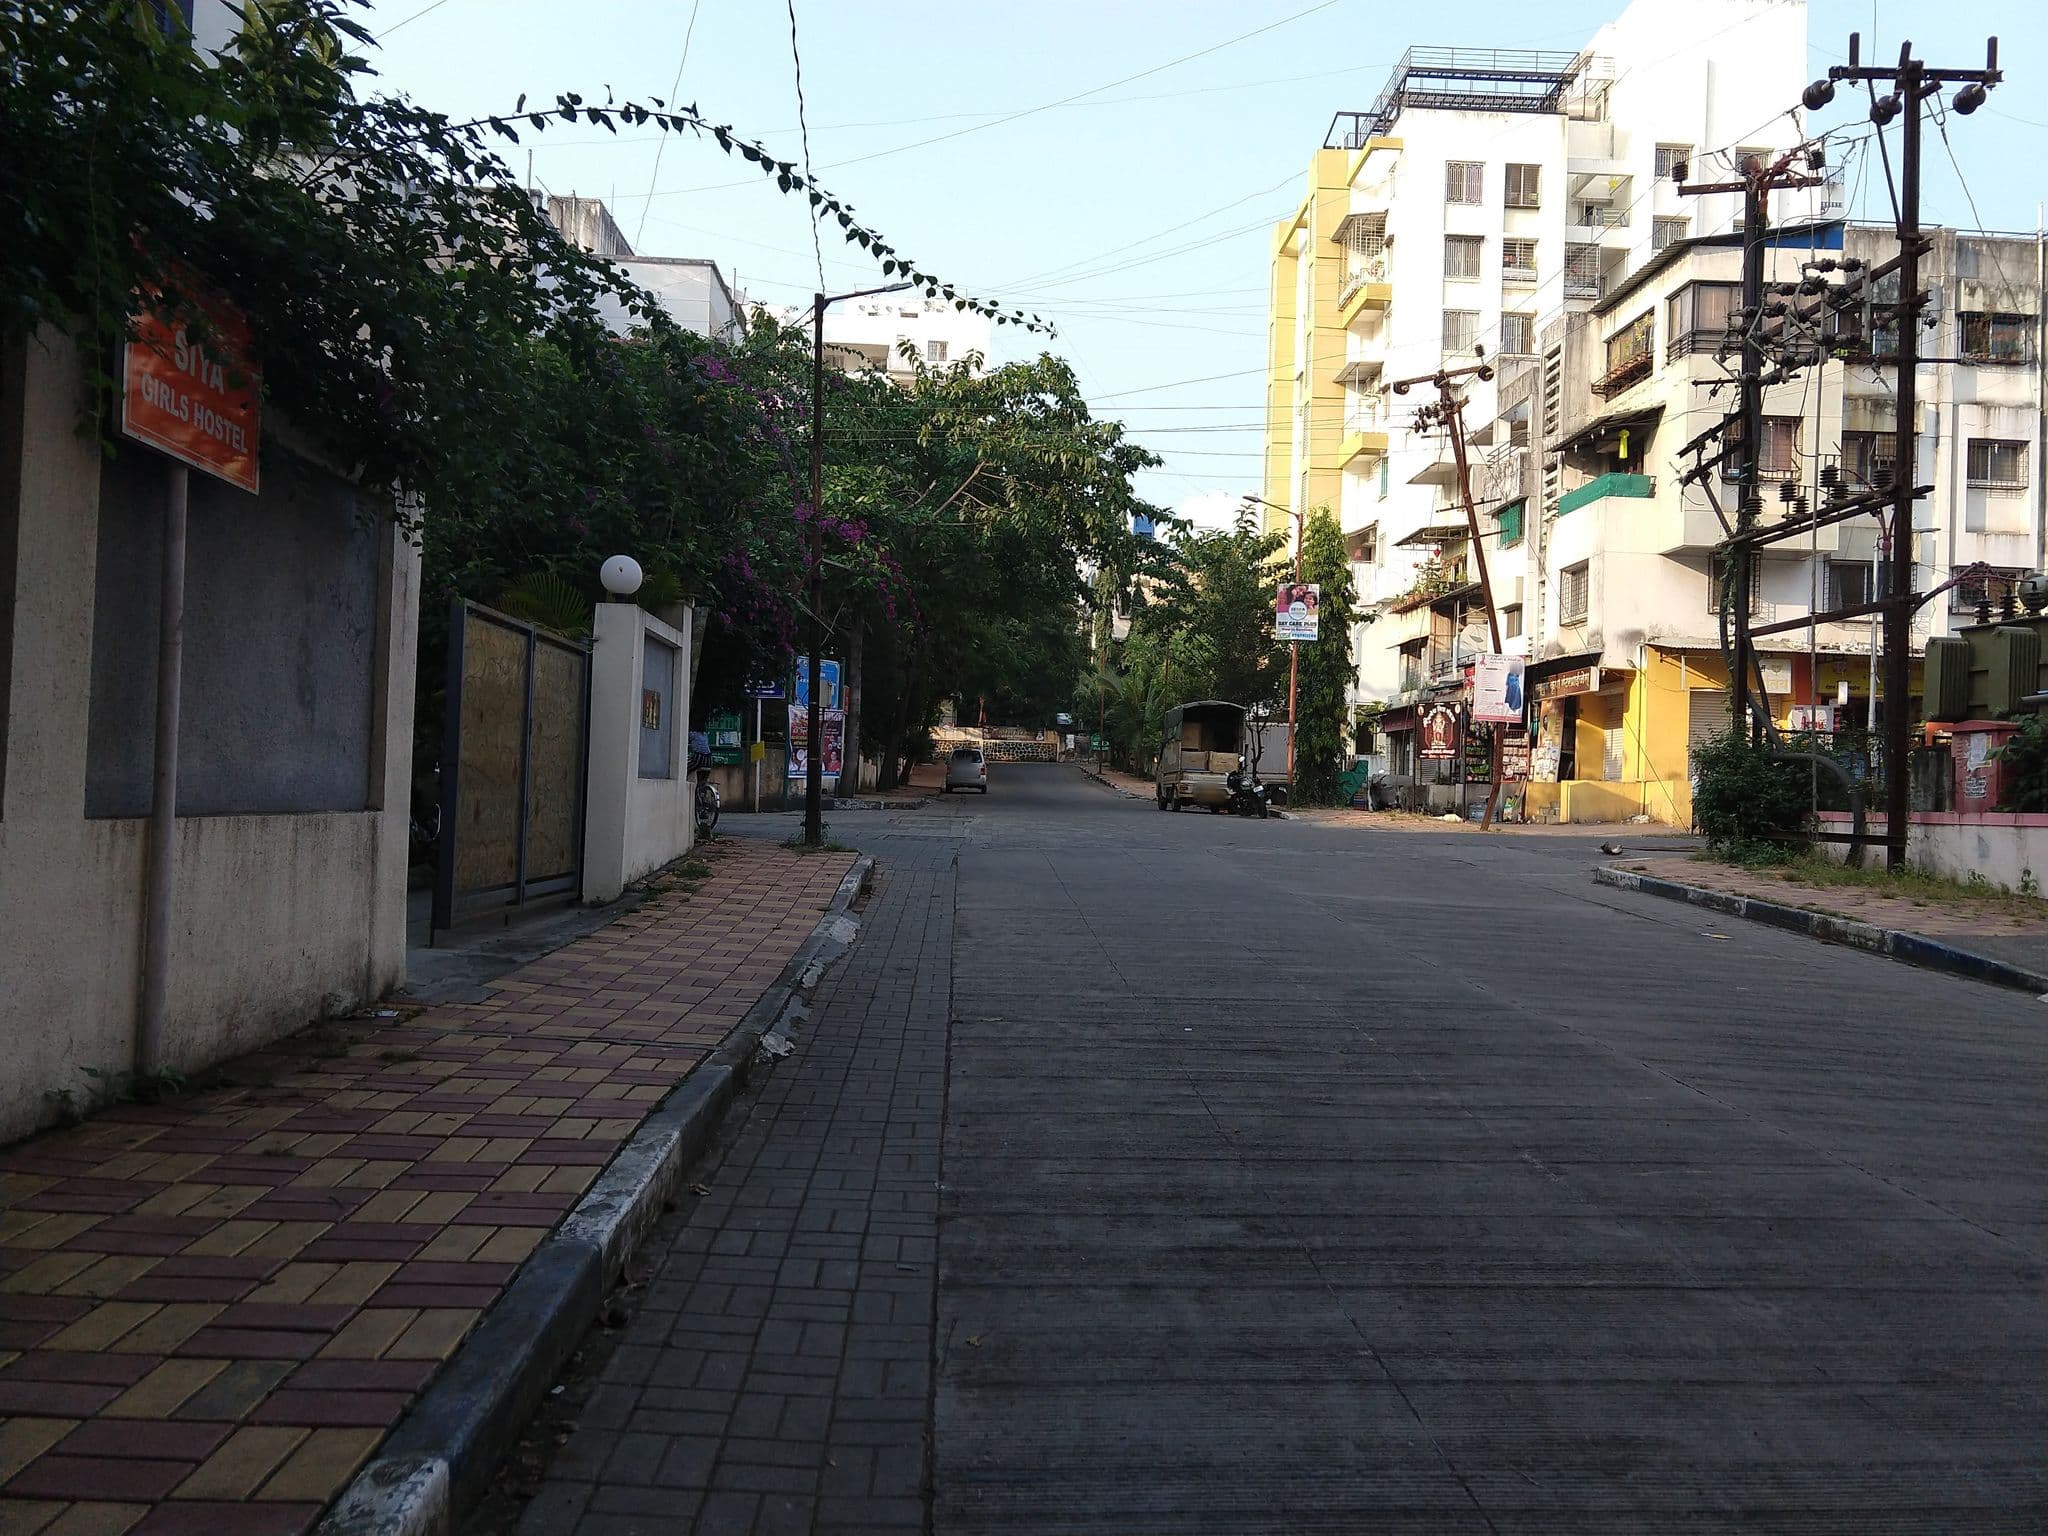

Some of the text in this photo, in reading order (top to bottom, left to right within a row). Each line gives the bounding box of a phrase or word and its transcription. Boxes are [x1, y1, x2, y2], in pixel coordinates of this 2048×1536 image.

[175, 330, 224, 394] SIYA
[141, 372, 248, 454] GIRLS HOSTEL
